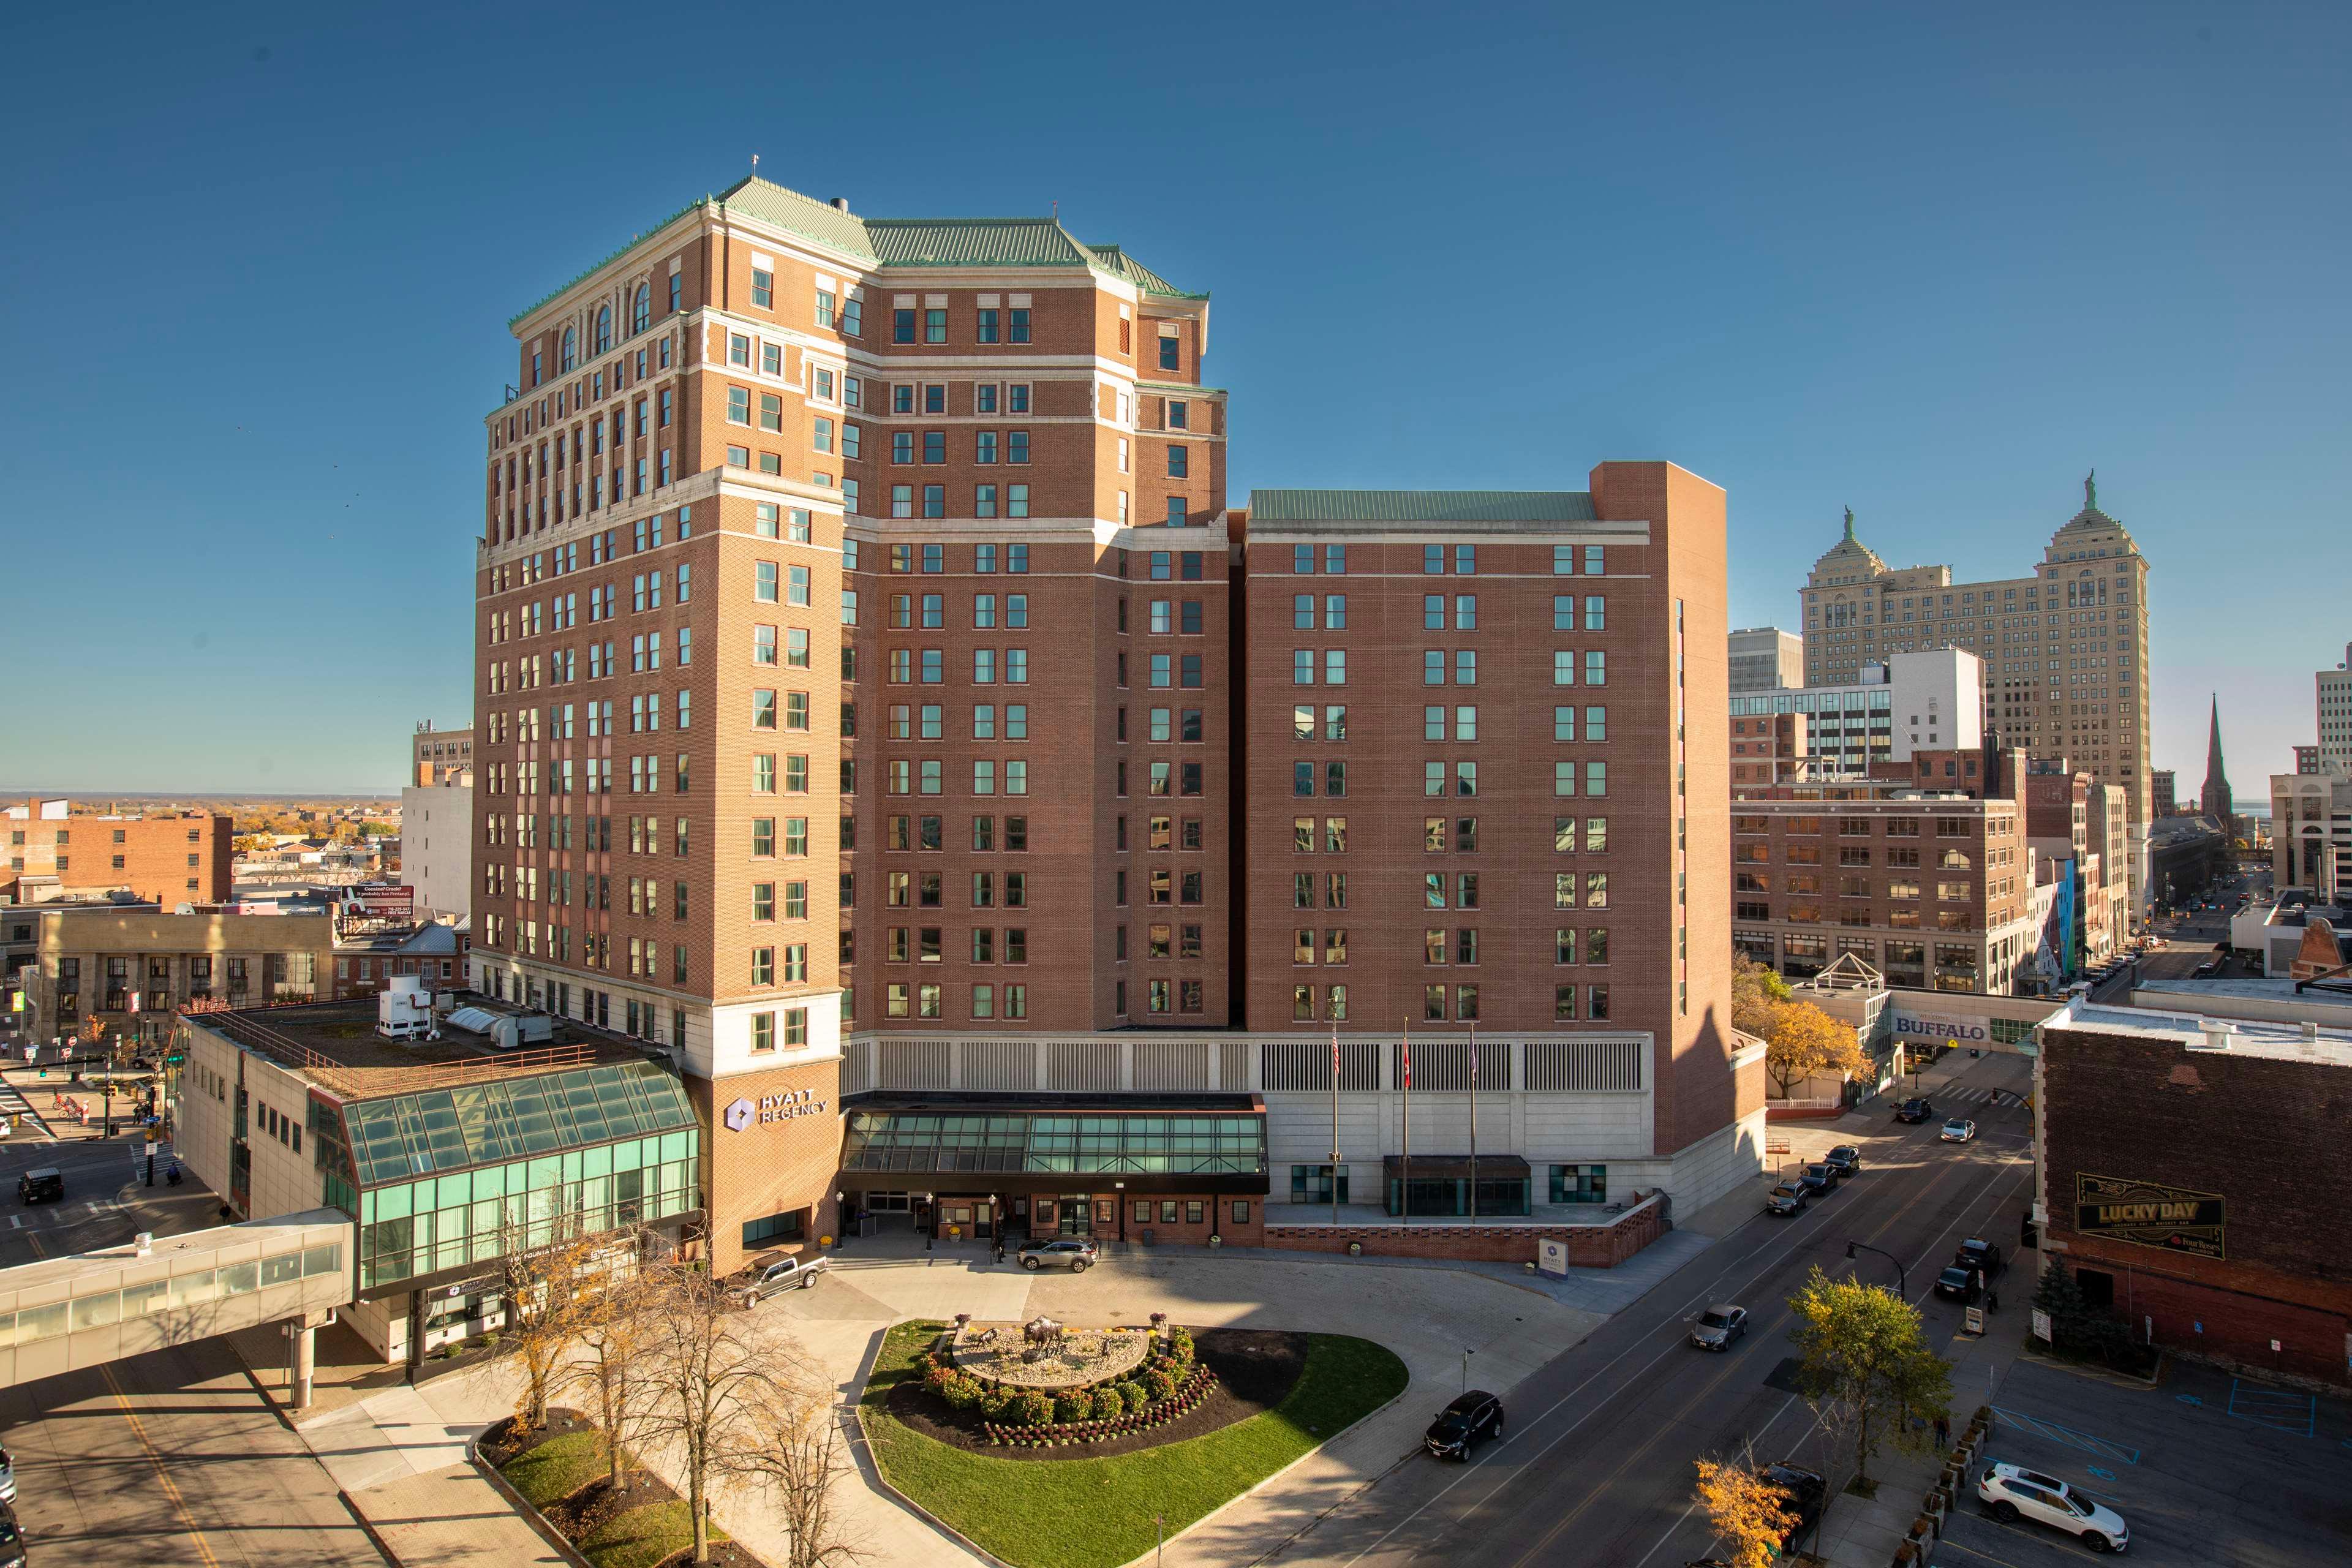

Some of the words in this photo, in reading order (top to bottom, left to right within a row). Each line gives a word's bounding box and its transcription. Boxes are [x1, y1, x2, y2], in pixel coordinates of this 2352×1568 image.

[1896, 1017, 1985, 1040] BUFFALO
[761, 1088, 814, 1109] HYATT
[761, 1100, 829, 1123] REGENCY
[2098, 1204, 2159, 1224] LUCKY
[2160, 1202, 2199, 1221] DAY
[2182, 1237, 2200, 1248] Four
[2199, 1240, 2220, 1251] Roses
[1544, 1256, 1561, 1265] HYATT
